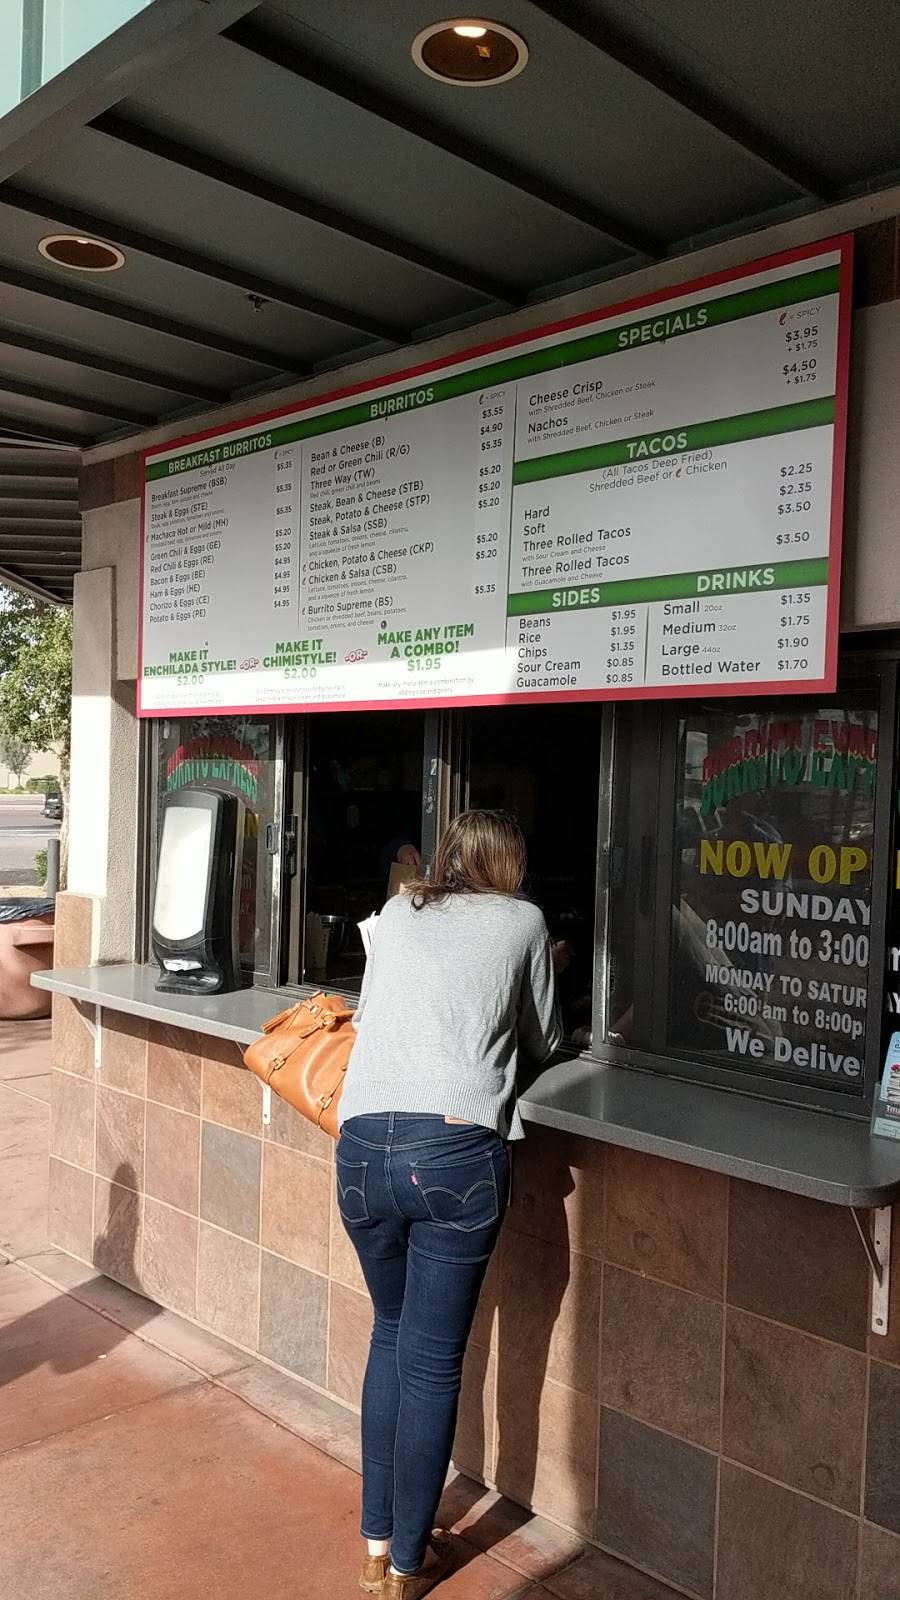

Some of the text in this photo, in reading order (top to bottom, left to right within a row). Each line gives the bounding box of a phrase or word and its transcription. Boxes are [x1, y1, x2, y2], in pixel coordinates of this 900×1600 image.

[618, 309, 708, 347] SPECIALS
[785, 327, 818, 342] $3.95
[795, 340, 818, 351] $1.75
[783, 359, 817, 376] $4.50
[794, 373, 817, 384] $1.75
[529, 379, 603, 406] Cheese Crisp
[529, 381, 656, 416] with Shredded Beef, Chicken or Steak
[371, 388, 434, 417] BURRITOS
[482, 406, 504, 419] $3.55
[480, 422, 503, 435] $4.90
[528, 416, 568, 434] Nachos
[311, 436, 385, 462] Bean & Cheese (B)
[481, 439, 502, 451] $5.35
[626, 433, 688, 459] TACOS
[168, 434, 272, 473] BREAKFAST BURRITOS
[311, 445, 410, 476] Red or Green Chili (R/G)
[277, 461, 292, 471] $5.35
[480, 465, 501, 477] $5.20
[602, 450, 713, 480] (All Tacos Deep Fried)
[781, 463, 812, 478] $2.25
[311, 468, 375, 490] Three Way (TW)
[589, 460, 727, 493] Shredded Beef or Chicken
[151, 489, 179, 502] Breakfast
[180, 480, 207, 496] Supreme
[208, 476, 227, 490] (BSB)
[780, 482, 811, 496] $2.35
[310, 494, 430, 526] Steak, Potato & Cheese (STP)
[524, 506, 550, 520] Hard
[777, 501, 811, 515] $3.50
[151, 531, 176, 541] Machaca
[177, 528, 188, 536] Hot
[198, 521, 212, 531] Mild
[213, 518, 228, 530] (MH)
[276, 528, 291, 537] $5.20
[524, 523, 545, 536] Soft
[477, 533, 498, 544] $5.20
[523, 526, 631, 552] Three Rolled Tacos
[776, 532, 810, 546] $3.50
[151, 552, 167, 561] Green
[169, 547, 182, 557] Chili
[190, 545, 205, 554] Eggs
[207, 541, 221, 552] (GE)
[309, 542, 434, 571] Chicken, Potato & Cheese (CKP)
[522, 554, 630, 578] Three Rolled Tacos
[275, 571, 290, 580] $4.95
[696, 568, 775, 592] DRINKS
[475, 584, 495, 595] $5.35
[150, 602, 172, 611] Chorizo
[179, 598, 194, 608] Eggs
[195, 596, 209, 605] (CE)
[552, 588, 600, 607] SIDES
[781, 593, 810, 605] $1.35
[308, 597, 393, 615] Burrito Supreme (BS)
[664, 601, 700, 615] Small
[519, 617, 551, 629] Beans
[612, 610, 636, 621] $1.95
[780, 615, 810, 627] $1.75
[378, 624, 474, 645] MAKE ANY ITEM
[611, 625, 635, 636] $1.95
[663, 621, 736, 636] Medium 32oz
[519, 633, 541, 644] Rice
[777, 637, 809, 649] $1.90
[276, 640, 323, 653] MAKE IT
[391, 641, 459, 658] A COMBO!
[518, 647, 547, 659] Chips
[611, 641, 635, 652] $1.35
[661, 642, 720, 657] Large 44oz
[170, 650, 208, 662] MAKE IT
[264, 652, 337, 668] CHIMISTYLE!
[607, 658, 634, 668] $0.85
[144, 660, 236, 676] ENCHILADA STYLE!
[407, 658, 441, 672] $1.95
[517, 659, 580, 673] Sour Cream
[661, 659, 760, 676] Bottled Water
[777, 659, 808, 671] $1.70
[177, 675, 204, 686] $2.00
[284, 667, 316, 679] $2.00
[606, 673, 633, 684] $0.85
[516, 674, 577, 688] Guacamole
[701, 840, 792, 880] NOW
[809, 845, 867, 885] OP
[741, 889, 870, 926] SUNDAY
[706, 919, 782, 957] 8:00am
[790, 929, 811, 960] to
[818, 929, 869, 967] 3:00
[706, 964, 775, 992] MONDAY
[780, 976, 802, 997] TO
[724, 993, 865, 1040] 6:00 am to 8:00p
[726, 1027, 864, 1076] We Delive
